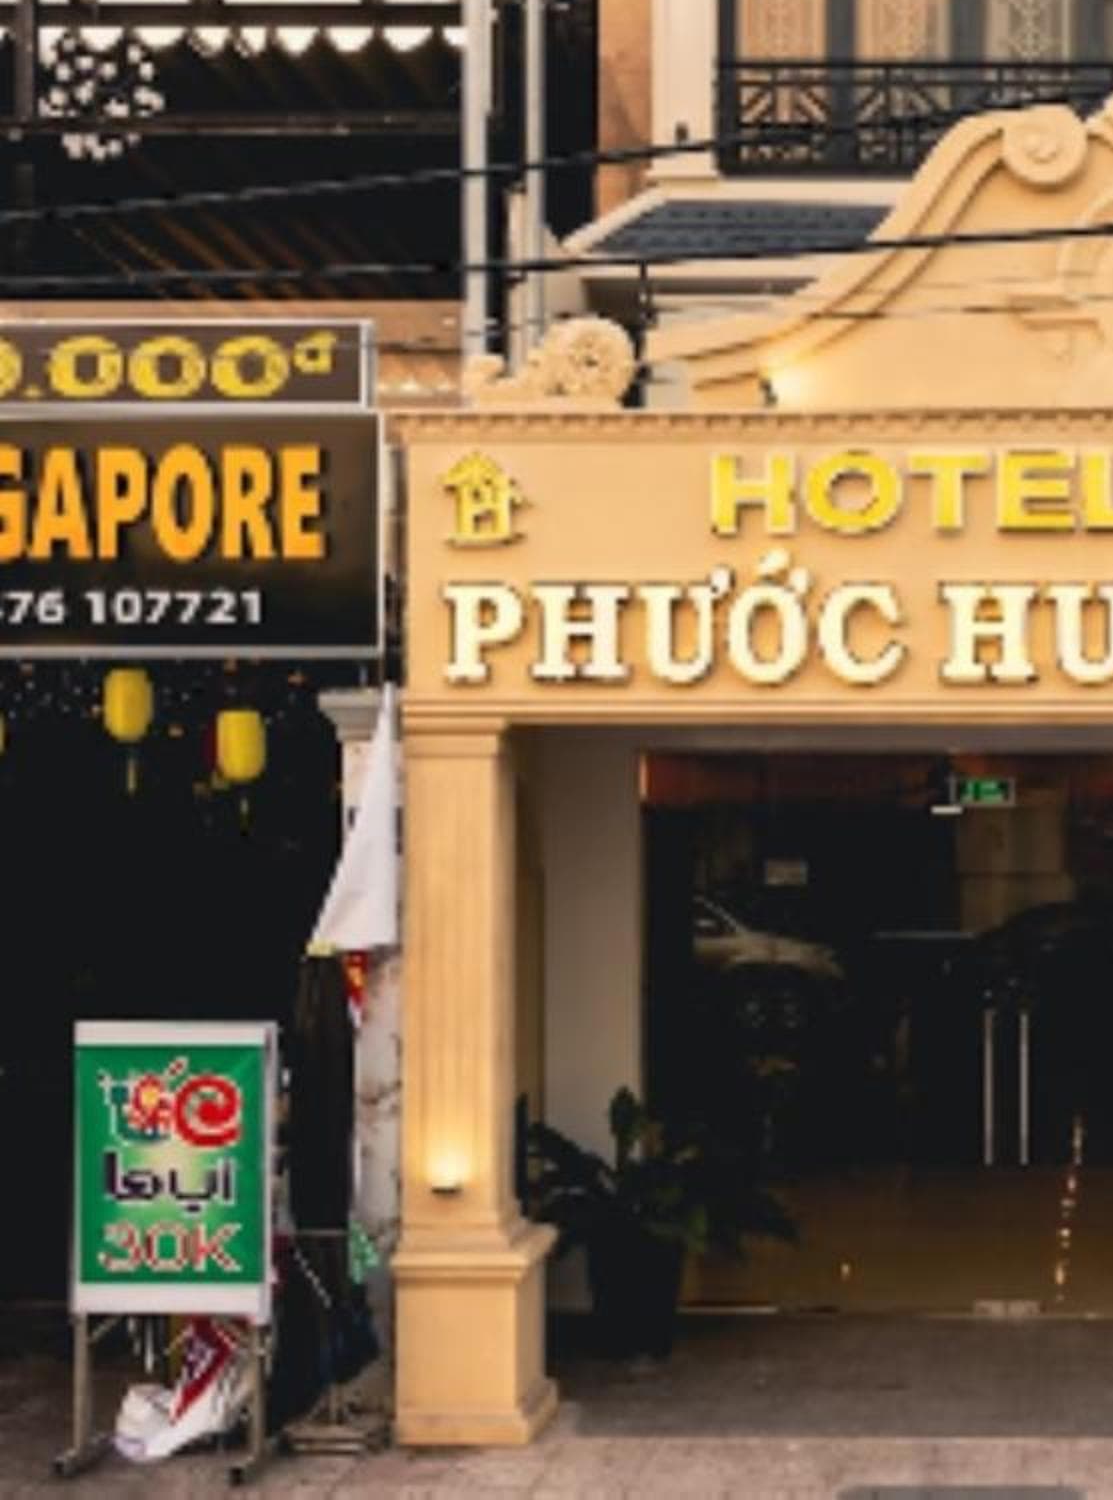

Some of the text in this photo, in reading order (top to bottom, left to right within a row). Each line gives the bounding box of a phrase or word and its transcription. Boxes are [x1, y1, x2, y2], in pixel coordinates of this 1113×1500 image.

[0, 590, 263, 625] 76 107721
[442, 548, 906, 686] PHƯỚC
